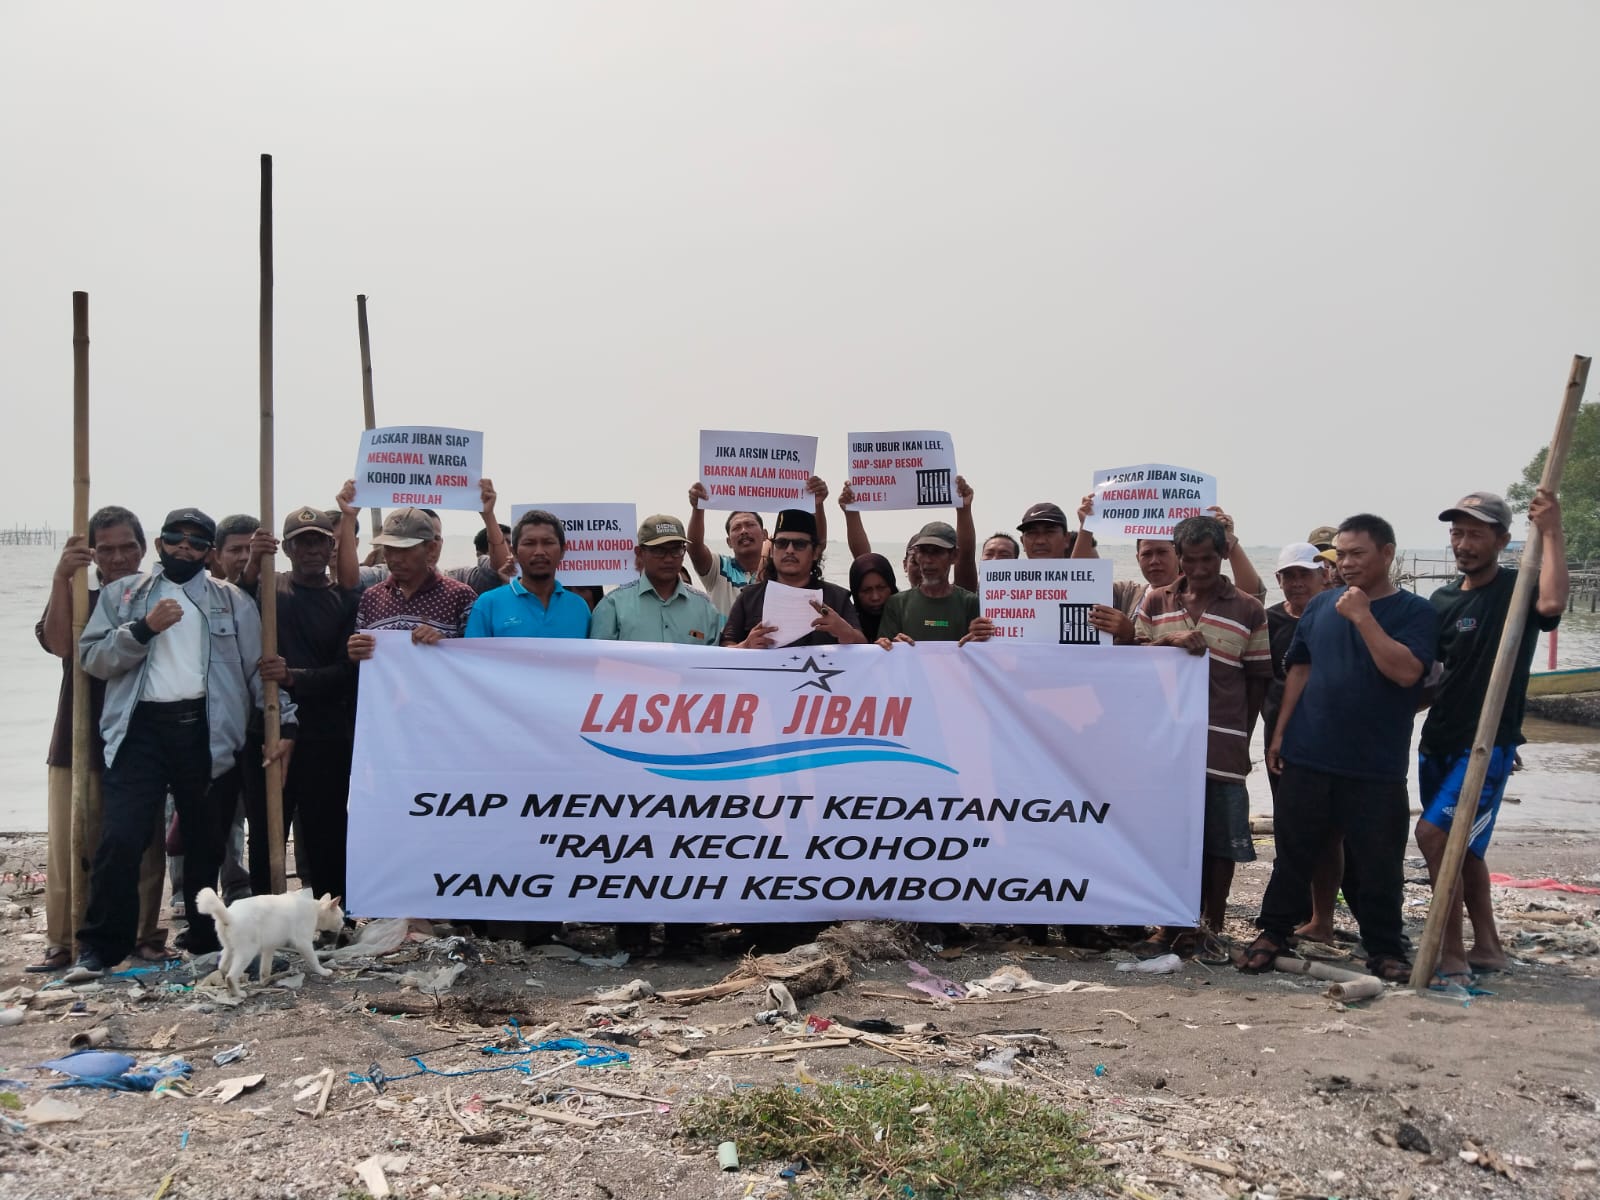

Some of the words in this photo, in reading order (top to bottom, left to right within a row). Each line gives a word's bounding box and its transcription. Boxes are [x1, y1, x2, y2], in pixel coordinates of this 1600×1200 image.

[371, 433, 408, 445] LASKAR
[411, 433, 442, 446] JIBAN
[445, 435, 470, 447] SIAP
[852, 442, 874, 453] UBUR
[876, 441, 900, 452] UBUR
[902, 440, 923, 451] IKAN
[925, 440, 944, 452] LELE,
[367, 452, 424, 465] MENGAWAL
[428, 453, 467, 467] WARGA
[715, 446, 736, 458] JIKA
[739, 447, 768, 460] ARSIN
[771, 448, 800, 463] LEPAS,
[852, 459, 893, 469] SIAP-SIAP
[895, 457, 924, 469] BESOK
[367, 471, 406, 484] KOHOD
[409, 473, 432, 485] JIKA
[435, 474, 468, 487] ARSIN
[704, 465, 747, 478] BIARKAN
[750, 466, 776, 479] ALAM
[778, 468, 810, 481] KOHOD
[1146, 470, 1177, 481] JIBAN
[1180, 472, 1204, 485] SIAP
[852, 475, 897, 486] DIPENJARA
[710, 484, 736, 496] YANG
[738, 485, 799, 499] MENGHUKUM
[854, 492, 871, 502] AGI
[873, 492, 882, 502] LE
[1102, 488, 1159, 501] MENGAWAL
[1162, 488, 1201, 500] WARGA
[392, 492, 442, 505] BERULAH
[1102, 508, 1139, 519] KOHOD
[1142, 508, 1165, 519] JIKA
[1168, 507, 1201, 519] ARSIN
[560, 519, 584, 531] RSIN
[587, 519, 621, 532] LEPAS,
[1124, 525, 1174, 535] BERULAH
[566, 539, 594, 551] ALAM
[597, 539, 633, 551] KOHOD
[986, 571, 1012, 582] UBUR
[1014, 570, 1042, 581] UBUR
[1044, 570, 1068, 581] IKAN
[1071, 570, 1095, 583] LELE,
[985, 589, 1033, 600] SIAP-SIAP
[1035, 589, 1068, 600] BESOK
[985, 608, 1036, 619] DIPENJARA
[993, 626, 1005, 637] GI
[1008, 626, 1018, 637] LE
[580, 693, 760, 734] LASKAR
[782, 694, 912, 737] JIBAN
[409, 792, 508, 818] SIAP
[520, 794, 814, 820] MENYAMBUT
[822, 796, 1110, 824] KEDATANGAN
[539, 834, 654, 864] "RAJA
[669, 835, 789, 861] KECIL
[805, 835, 990, 861] KOHOD"
[433, 873, 554, 899] YANG
[568, 874, 728, 900] PENUH
[740, 875, 1089, 902] KESOMBONGAN
